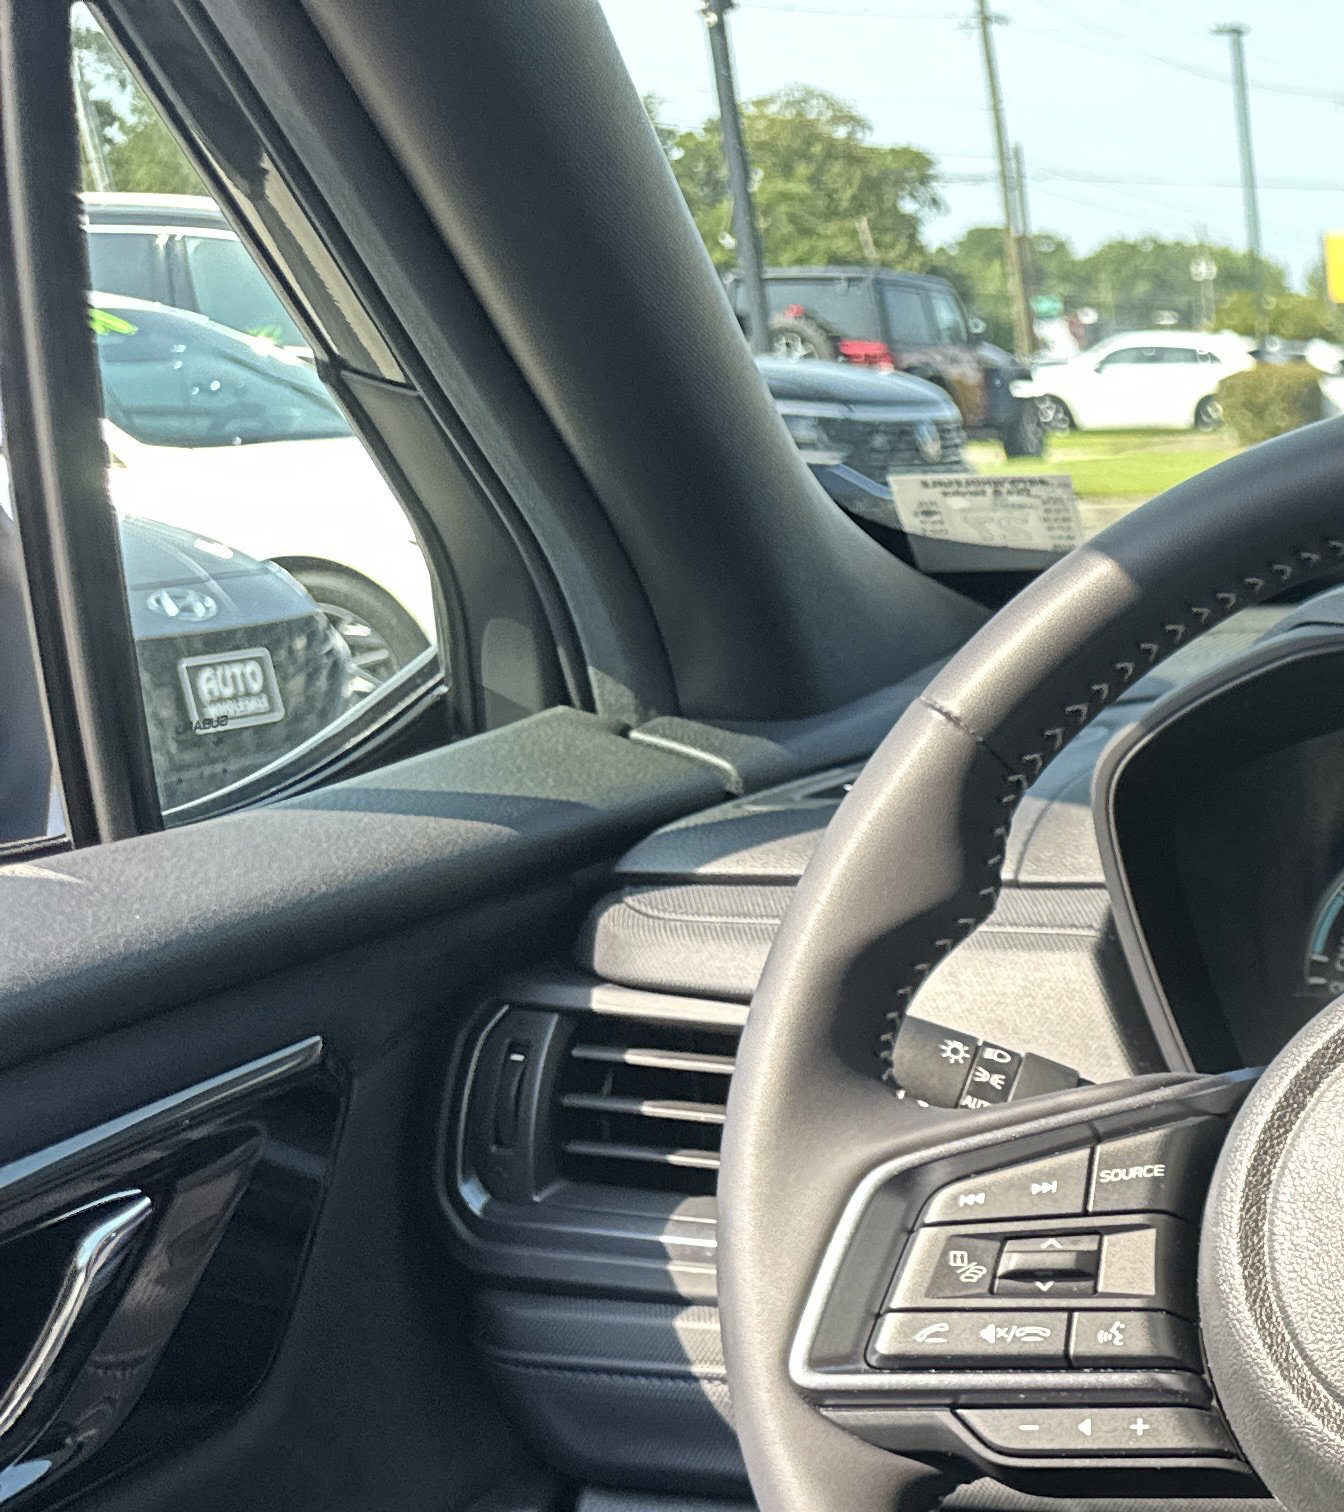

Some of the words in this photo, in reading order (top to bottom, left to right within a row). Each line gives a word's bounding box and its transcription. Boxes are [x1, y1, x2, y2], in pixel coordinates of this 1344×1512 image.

[197, 660, 264, 702] AUTO
[960, 1095, 990, 1109] AUT
[1099, 1164, 1166, 1183] SOURCE
